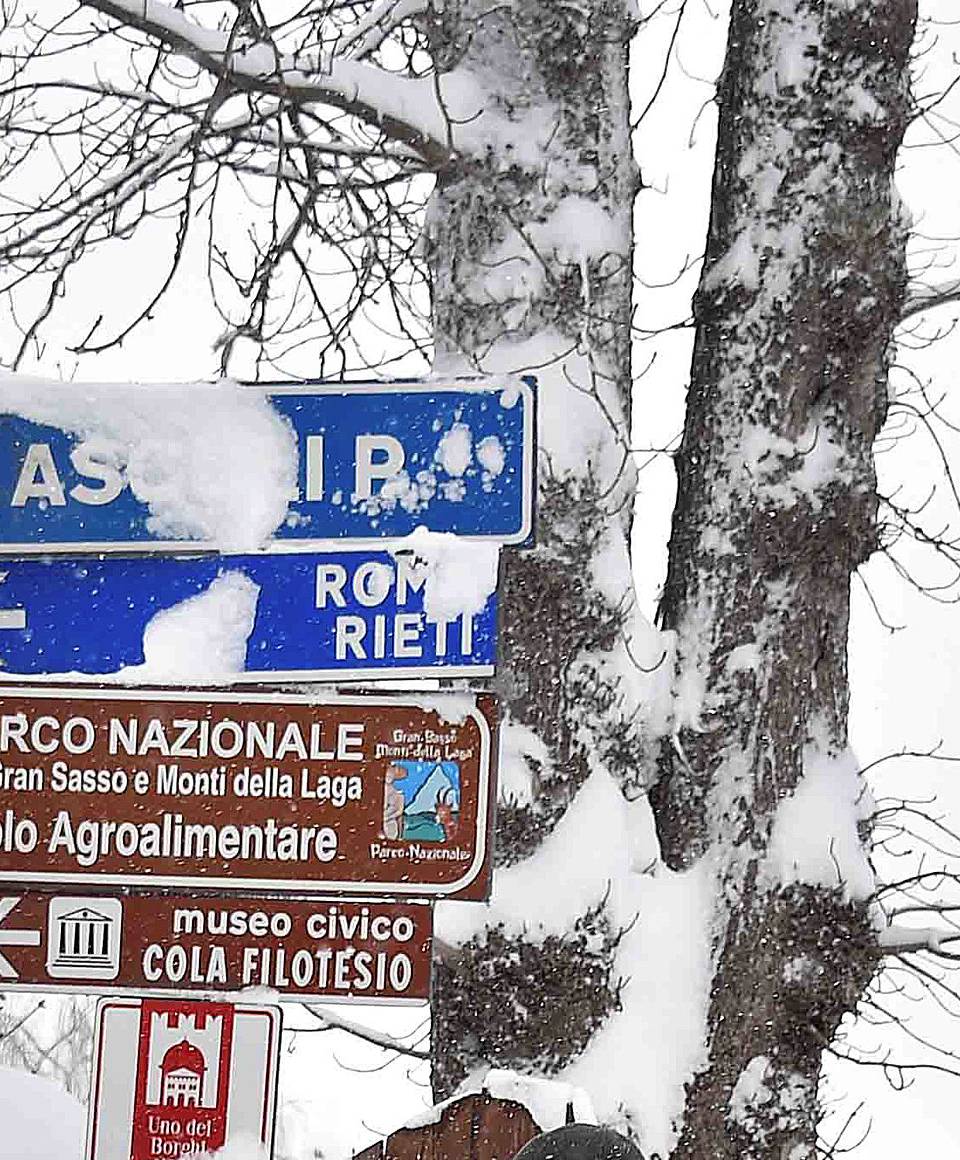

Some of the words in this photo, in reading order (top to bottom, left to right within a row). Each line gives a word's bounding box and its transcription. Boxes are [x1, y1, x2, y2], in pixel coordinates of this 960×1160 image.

[335, 614, 474, 661] RIETI
[108, 718, 366, 762] NAZIONALE
[51, 761, 128, 794] Sasso
[134, 770, 149, 795] e
[156, 764, 226, 796] Monti
[232, 767, 293, 800] della
[301, 773, 363, 807] Laga
[48, 810, 338, 866] Agroalimentare
[370, 843, 405, 860] Parco
[172, 906, 292, 938] museo
[306, 908, 414, 943] civico
[142, 944, 228, 984] COLA
[243, 946, 413, 993] FILOTESIO
[148, 1115, 181, 1135] Uno
[185, 1118, 211, 1137] dei
